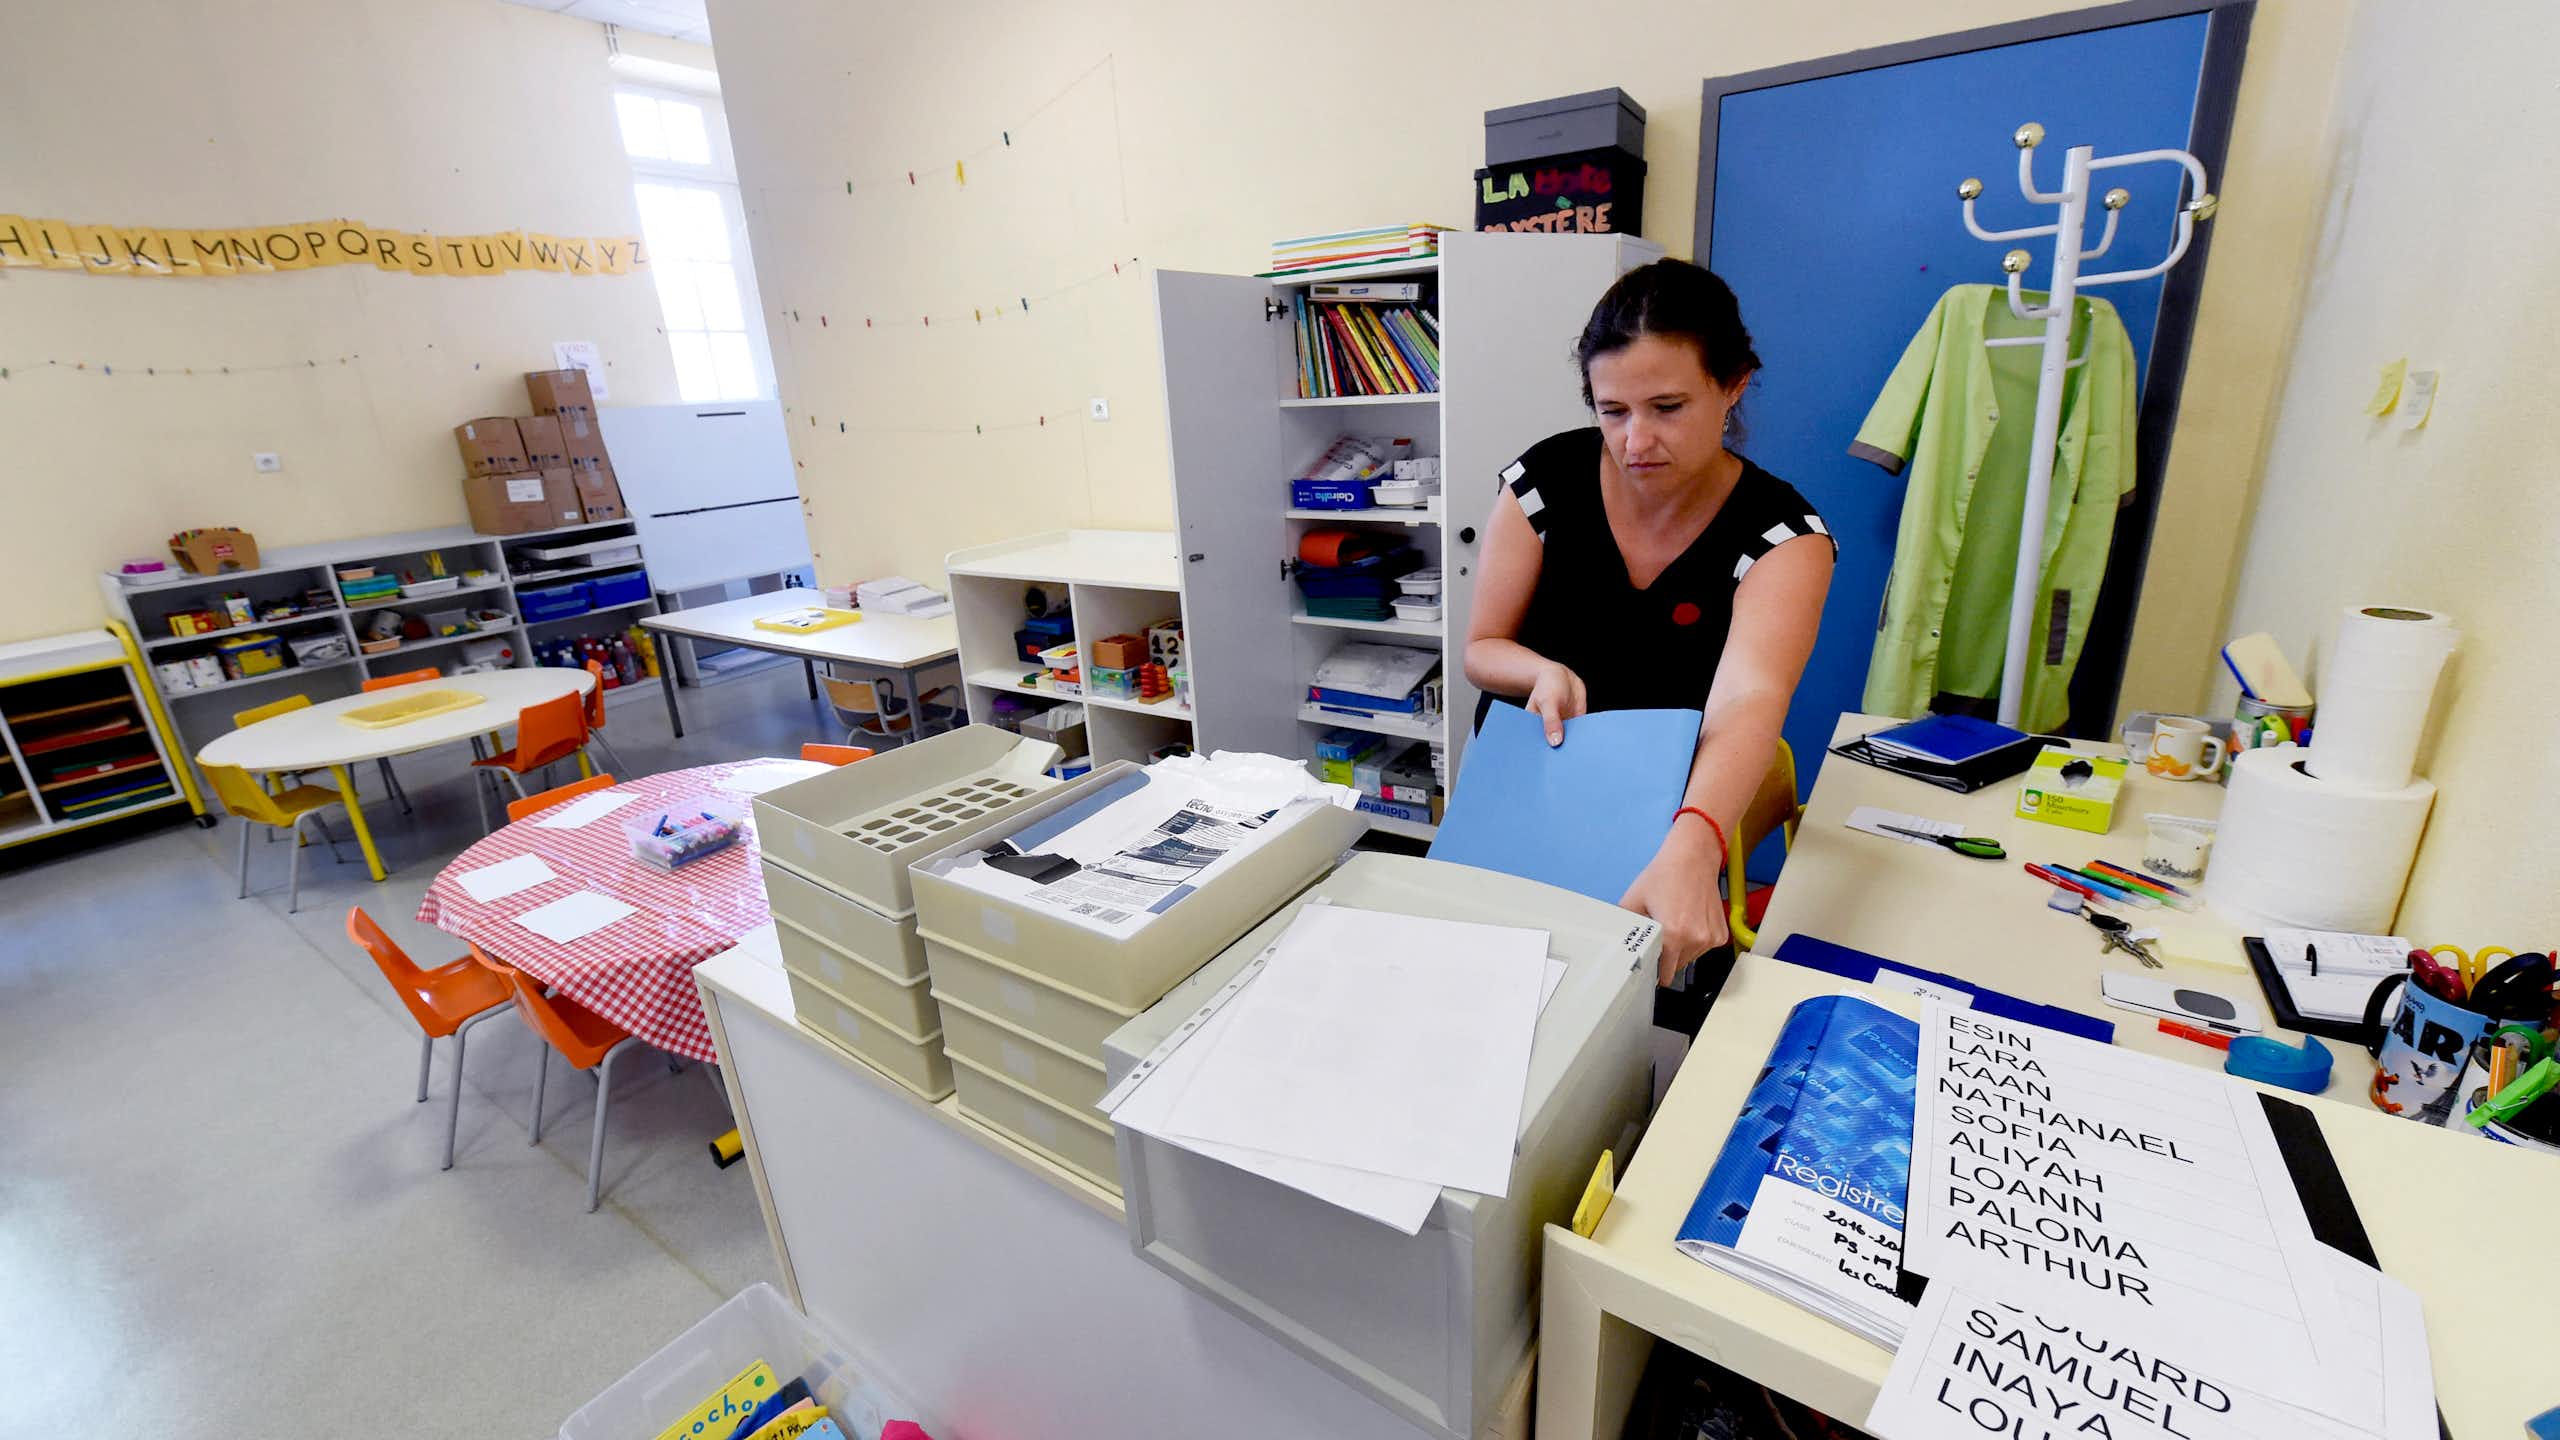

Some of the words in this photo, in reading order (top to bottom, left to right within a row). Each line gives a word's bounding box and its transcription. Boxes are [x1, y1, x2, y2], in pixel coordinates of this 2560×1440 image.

[1482, 172, 1530, 204] LA
[1950, 1015, 2031, 1052] ESIN
[1950, 1036, 2047, 1078] LARA
[1948, 1057, 2051, 1102] KAAN
[1939, 1077, 2194, 1164] NATHANAEL
[1951, 1105, 2077, 1160] SOFIA
[1774, 1153, 1905, 1224] Registre
[1949, 1131, 2104, 1193] ALIYAH
[1950, 1156, 2103, 1223] LOANN
[1950, 1186, 2149, 1269] PALOMA
[1945, 1220, 2153, 1306] ARTHUR
[1953, 1341, 2113, 1440] INAYA
[1966, 1309, 2191, 1440] SAMUEL
